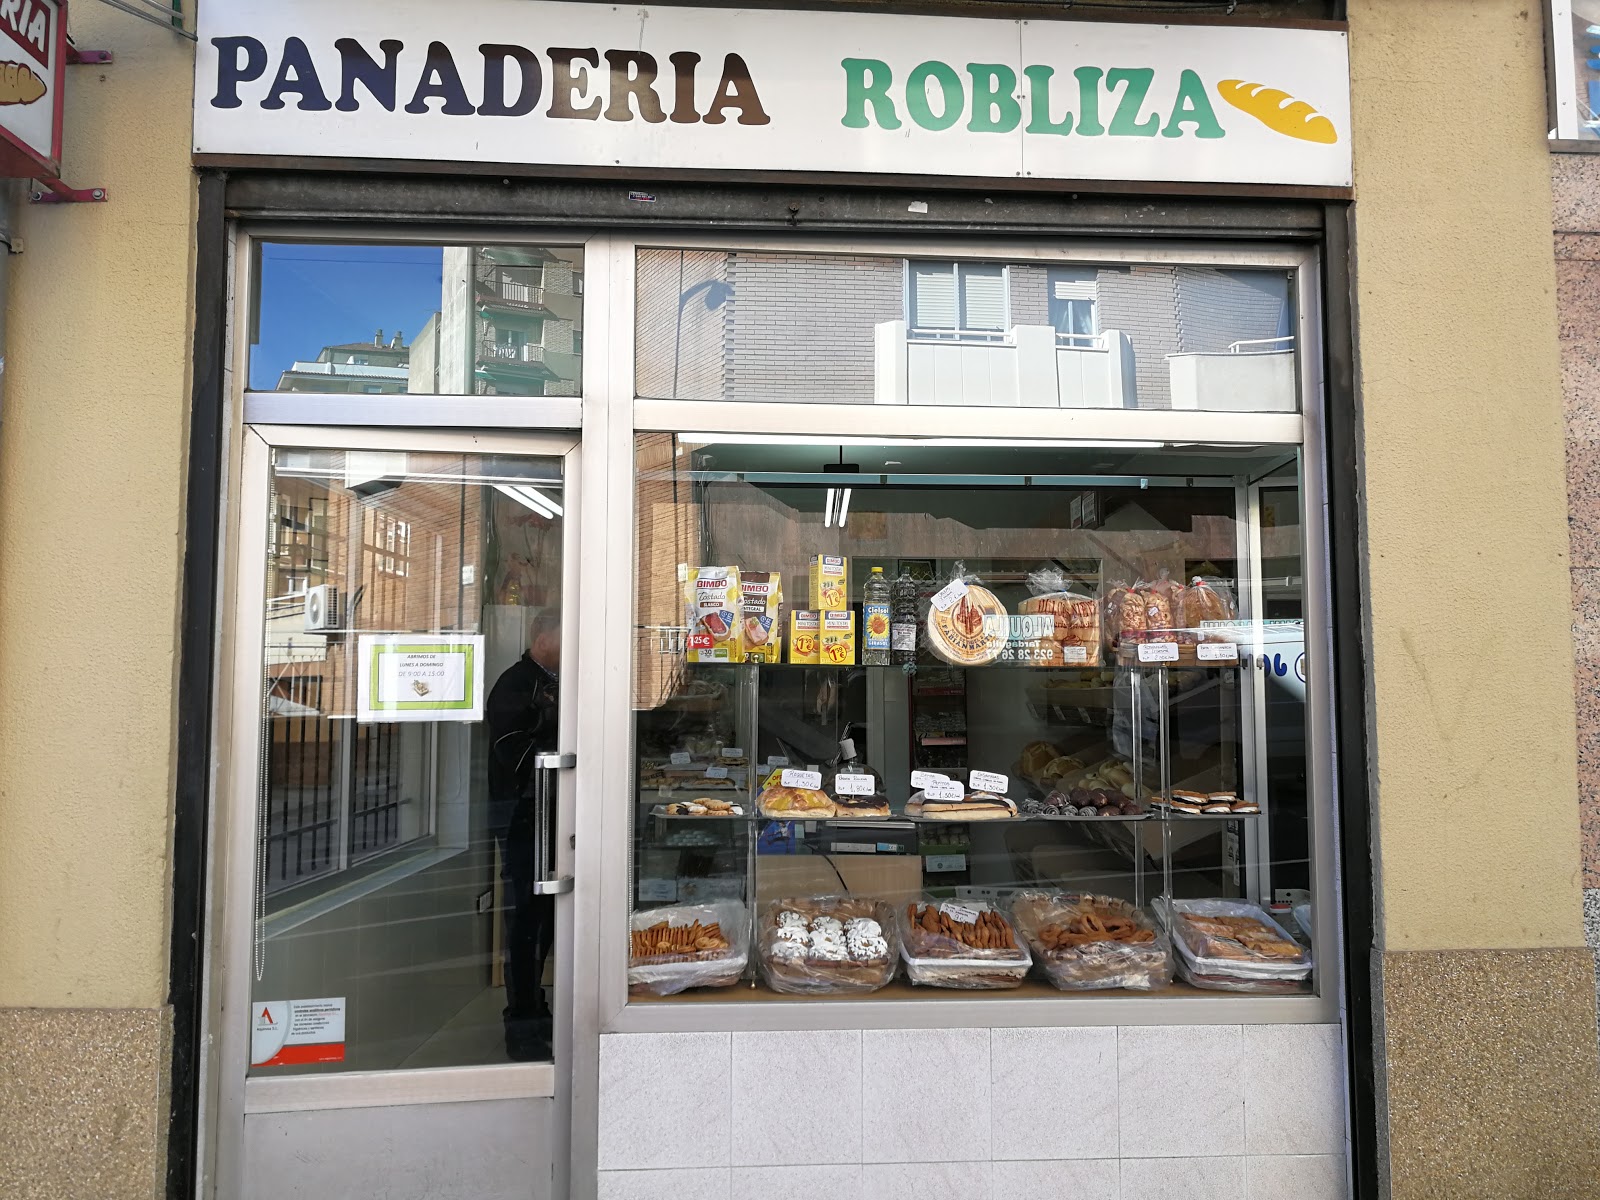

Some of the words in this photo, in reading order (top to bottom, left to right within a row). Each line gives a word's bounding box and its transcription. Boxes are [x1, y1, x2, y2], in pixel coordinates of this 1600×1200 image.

[210, 35, 771, 126] PANADERIA
[840, 57, 1226, 140] ROBLIZA
[696, 579, 728, 588] BIMBO
